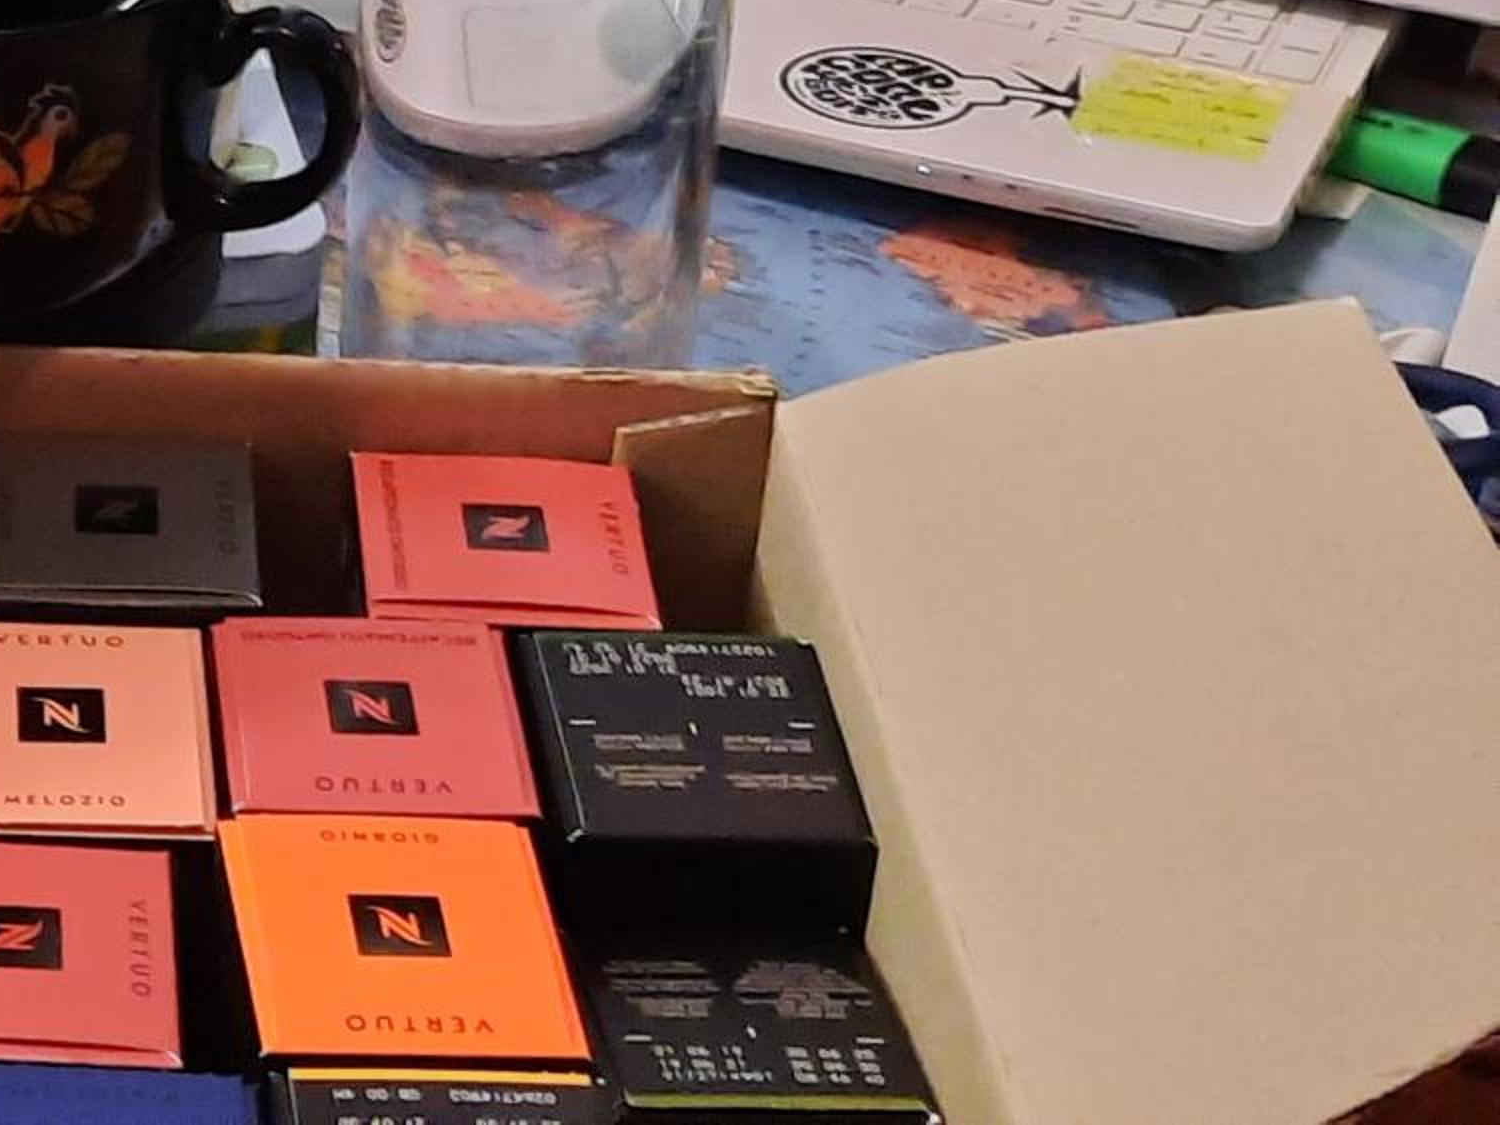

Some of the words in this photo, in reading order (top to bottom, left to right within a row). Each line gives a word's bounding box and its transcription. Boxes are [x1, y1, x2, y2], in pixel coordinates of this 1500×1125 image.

[599, 501, 629, 576] VERTUO
[314, 776, 453, 795] VERTUO
[3, 794, 127, 808] MELOZIO
[130, 898, 152, 997] VERTUO
[345, 1014, 495, 1034] VERTUO
